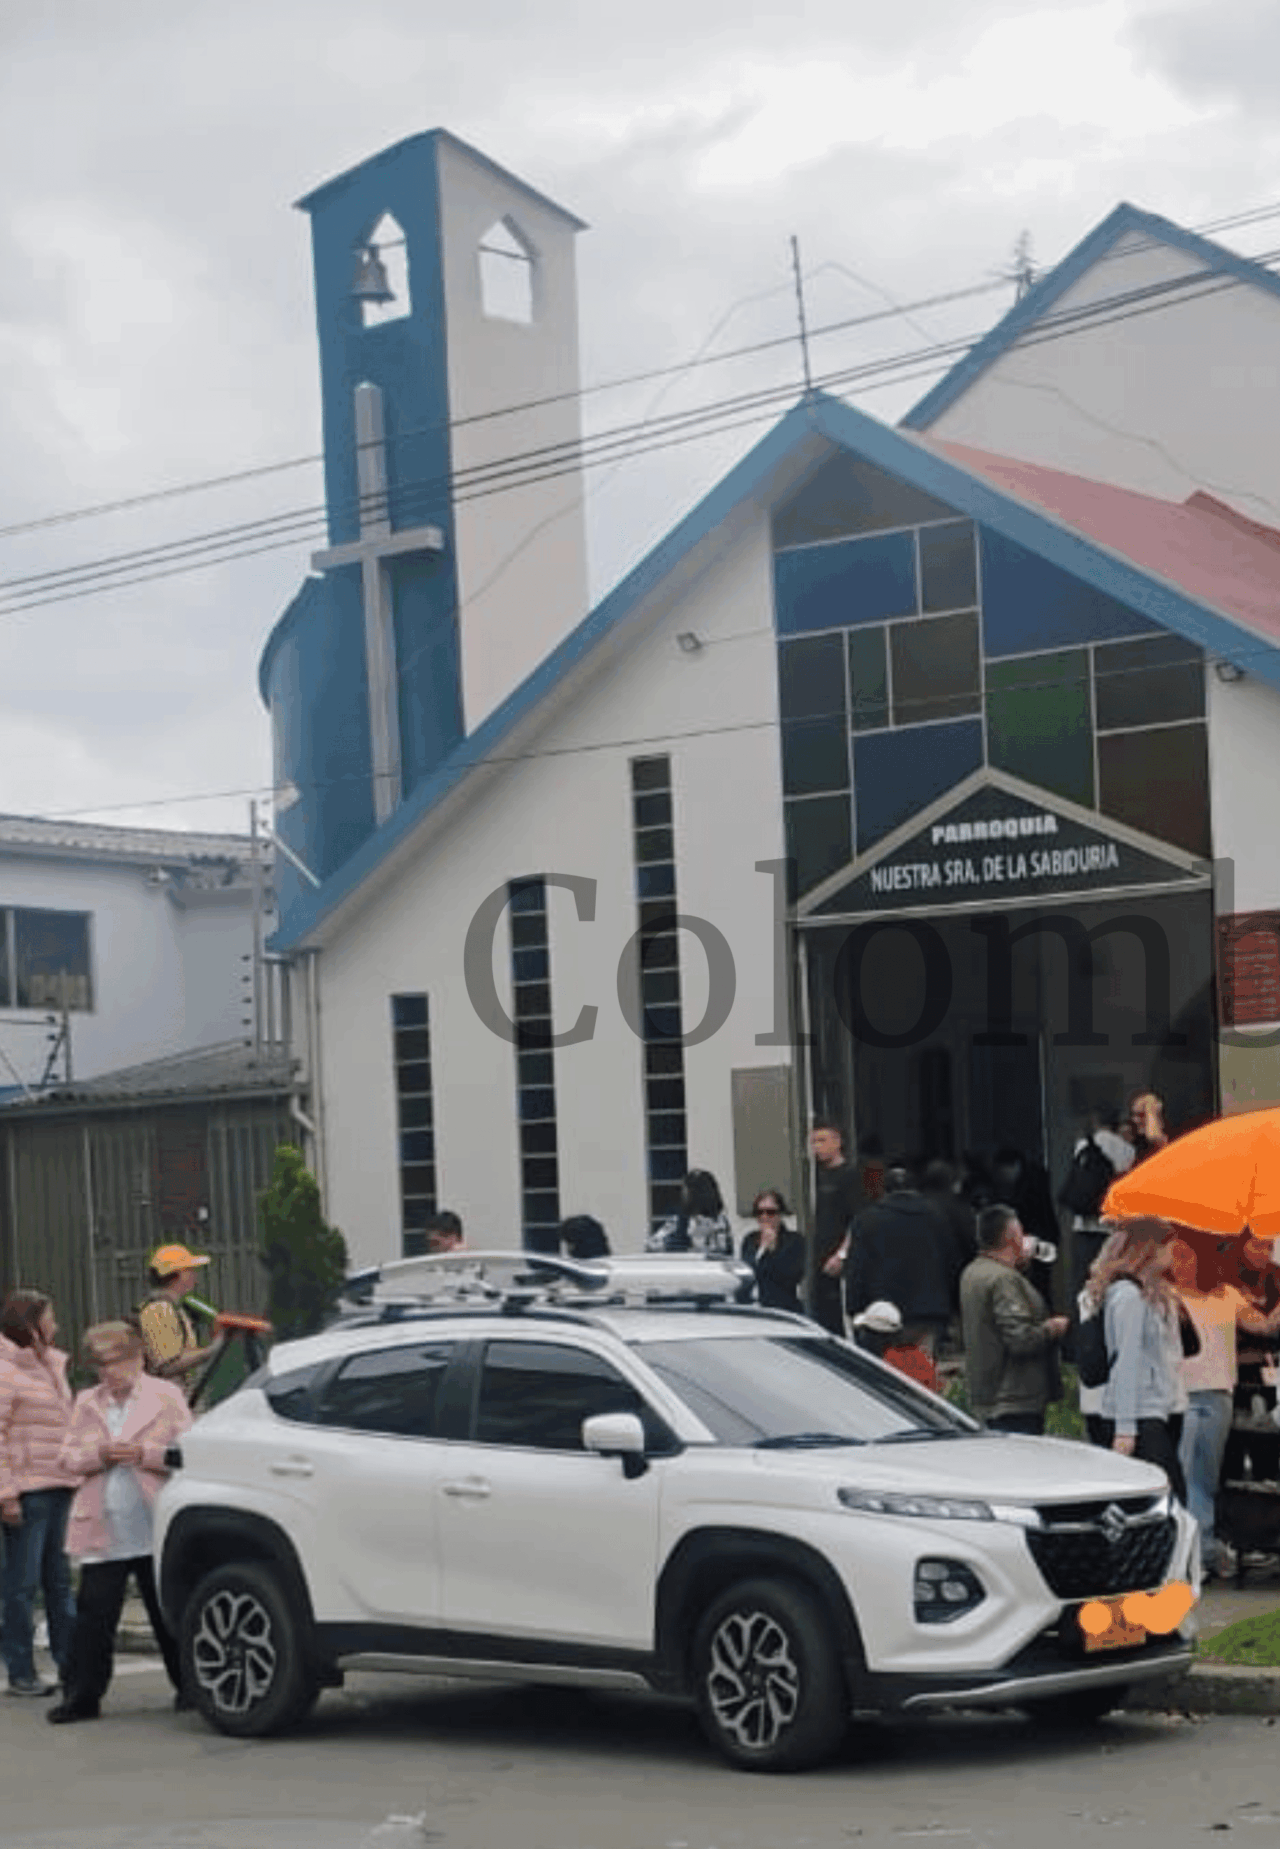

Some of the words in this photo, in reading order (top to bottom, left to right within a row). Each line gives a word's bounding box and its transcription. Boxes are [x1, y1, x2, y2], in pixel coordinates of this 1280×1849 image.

[933, 815, 1058, 844] PARROQUIA
[872, 863, 941, 892] NUESTRA
[943, 858, 980, 885] SRA.
[982, 854, 1003, 881] DE
[1007, 852, 1027, 879] LA
[1031, 844, 1119, 877] SABIDURIA
